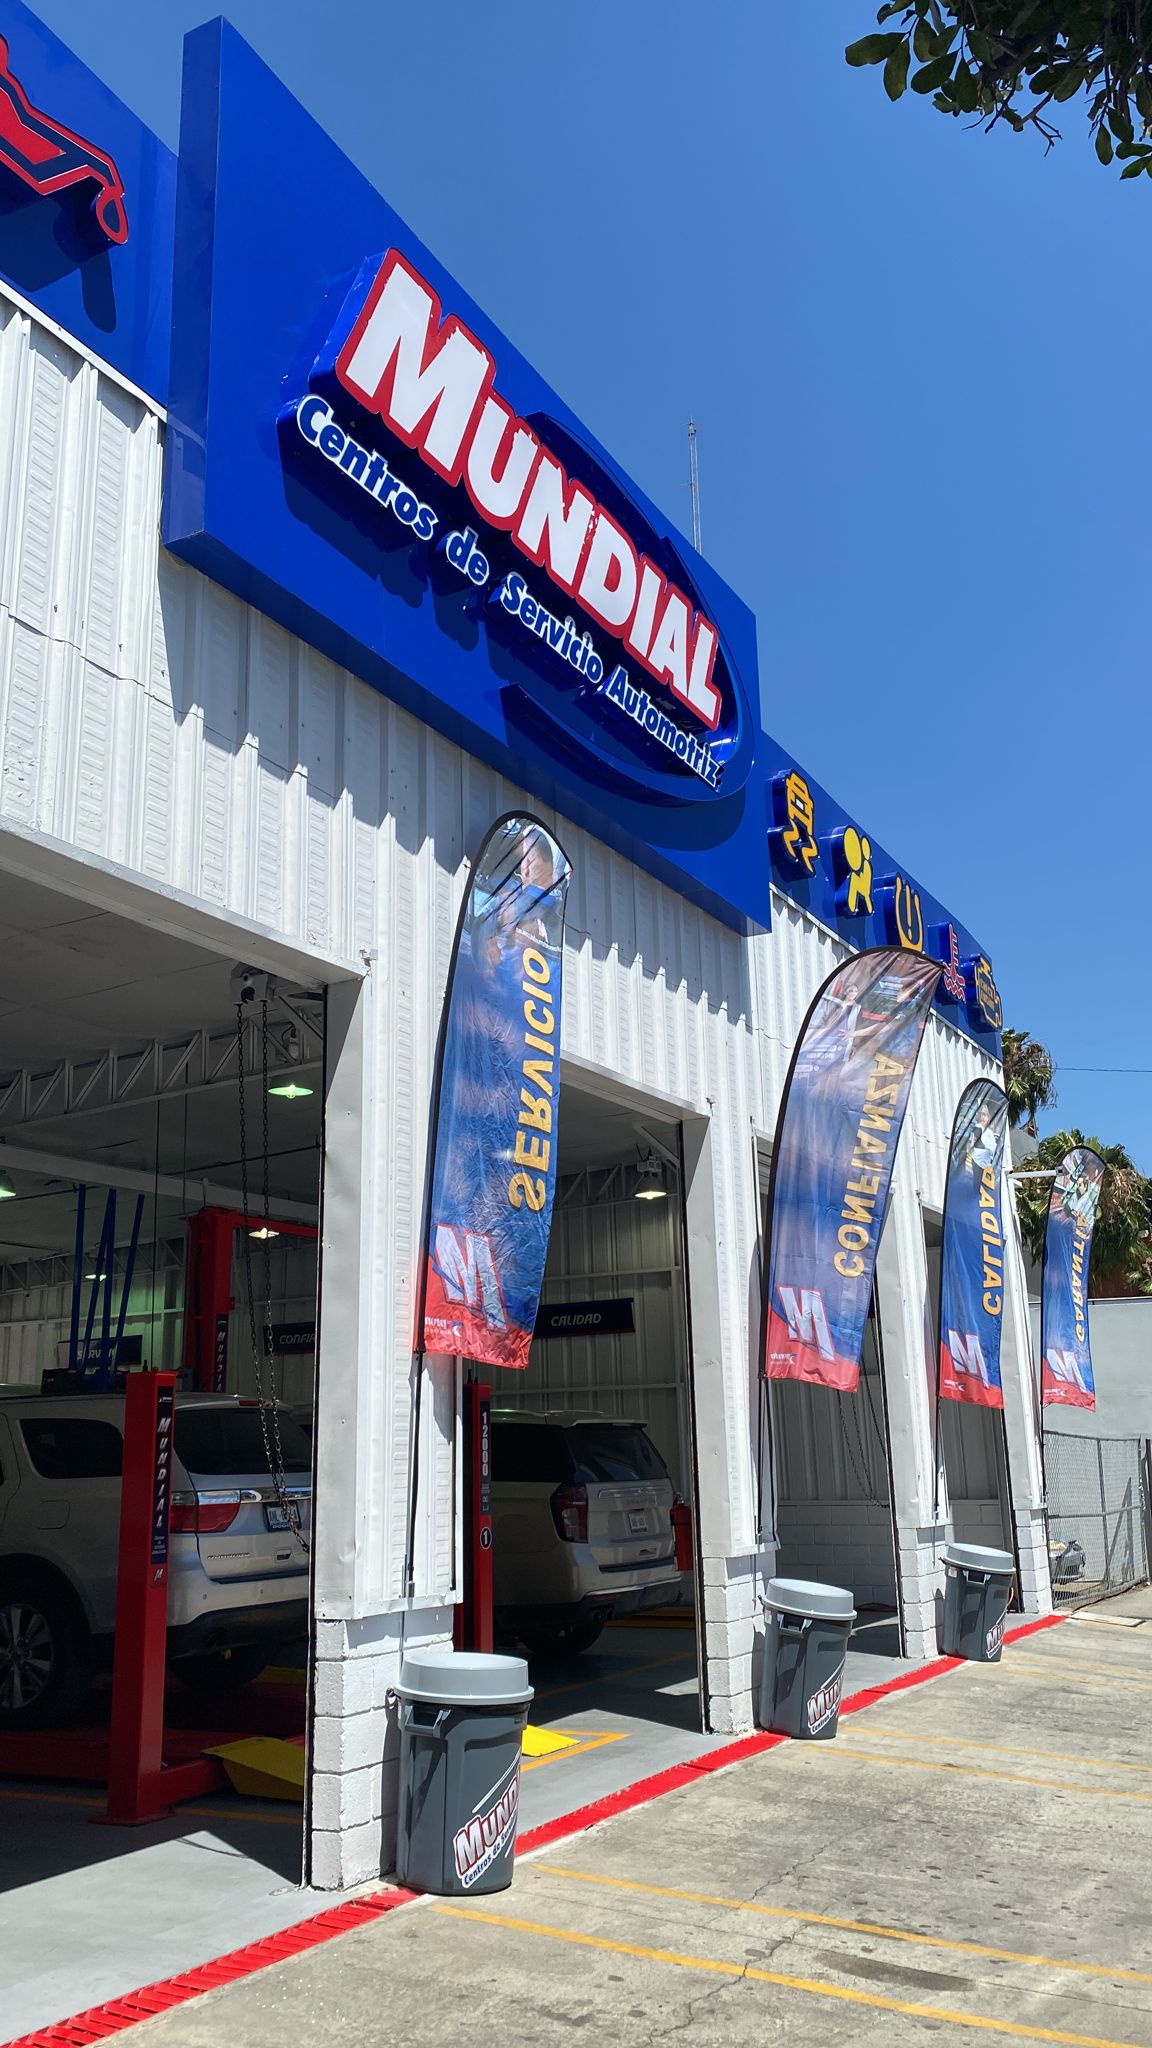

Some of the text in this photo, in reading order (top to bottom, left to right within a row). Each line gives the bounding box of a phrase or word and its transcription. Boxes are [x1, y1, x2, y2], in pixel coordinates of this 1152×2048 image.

[297, 395, 722, 788] Centros de Servicio Automotriz
[338, 248, 721, 729] MUNDIAL
[551, 1313, 602, 1327] CALIDAD
[464, 1854, 492, 1886] Centros
